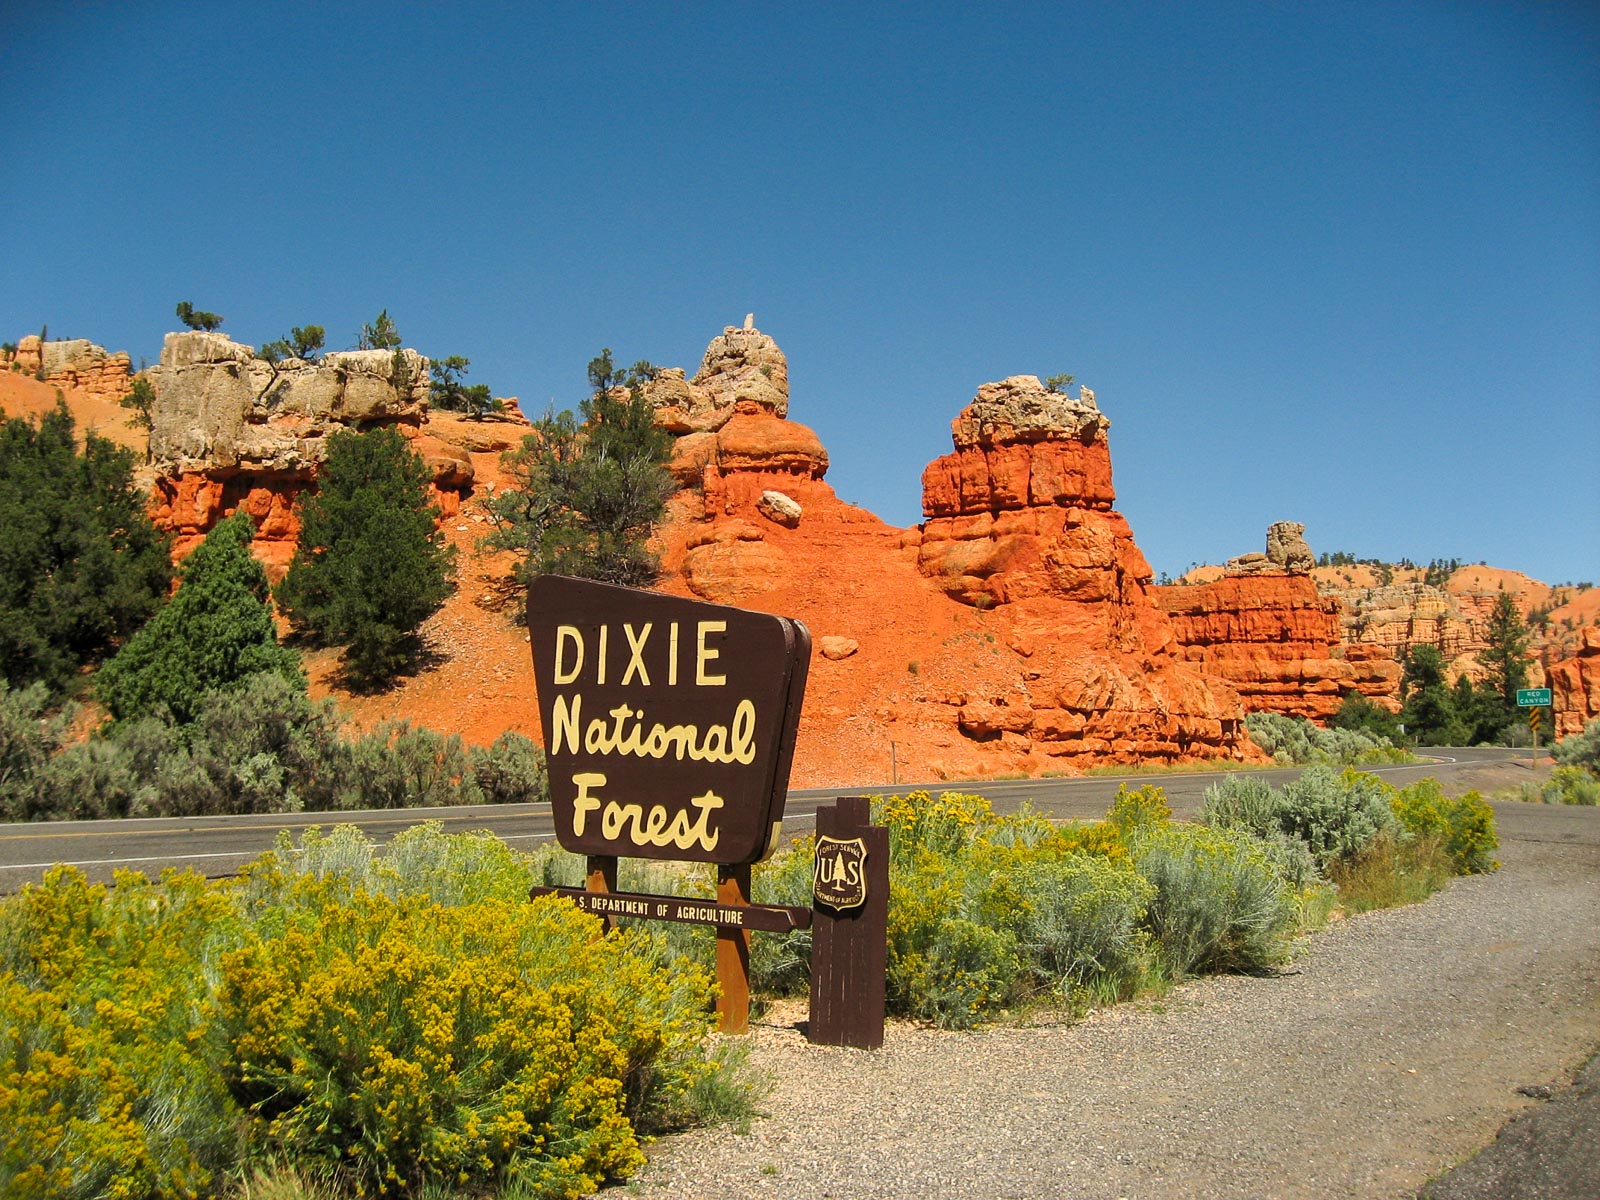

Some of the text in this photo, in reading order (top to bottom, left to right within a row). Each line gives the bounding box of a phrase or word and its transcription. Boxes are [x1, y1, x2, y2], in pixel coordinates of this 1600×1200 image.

[554, 620, 727, 686] DIXIE
[552, 694, 756, 765] National
[571, 773, 724, 851] Forest
[591, 897, 649, 916] DEPARTMENT
[657, 904, 669, 917] OF
[677, 905, 743, 925] AGRICULTURE
